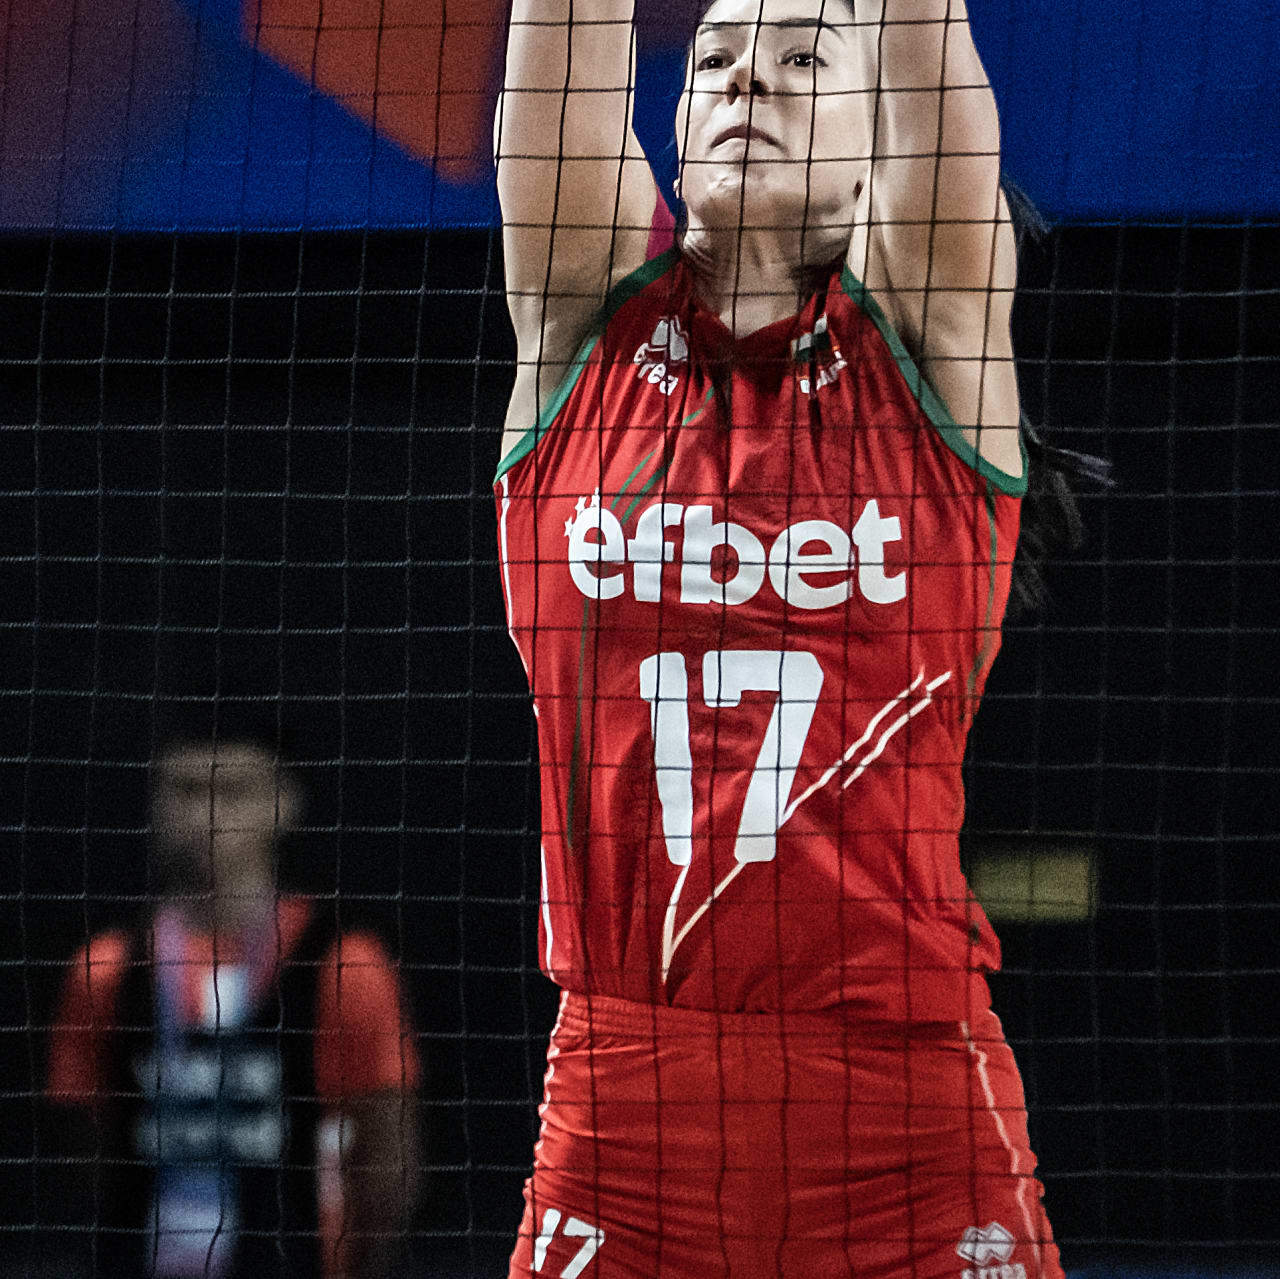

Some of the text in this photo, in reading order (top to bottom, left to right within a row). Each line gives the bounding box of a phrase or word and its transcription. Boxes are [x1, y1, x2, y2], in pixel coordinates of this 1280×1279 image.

[567, 498, 908, 610] efbet
[639, 650, 825, 867] 17
[529, 1207, 605, 1279] 17
